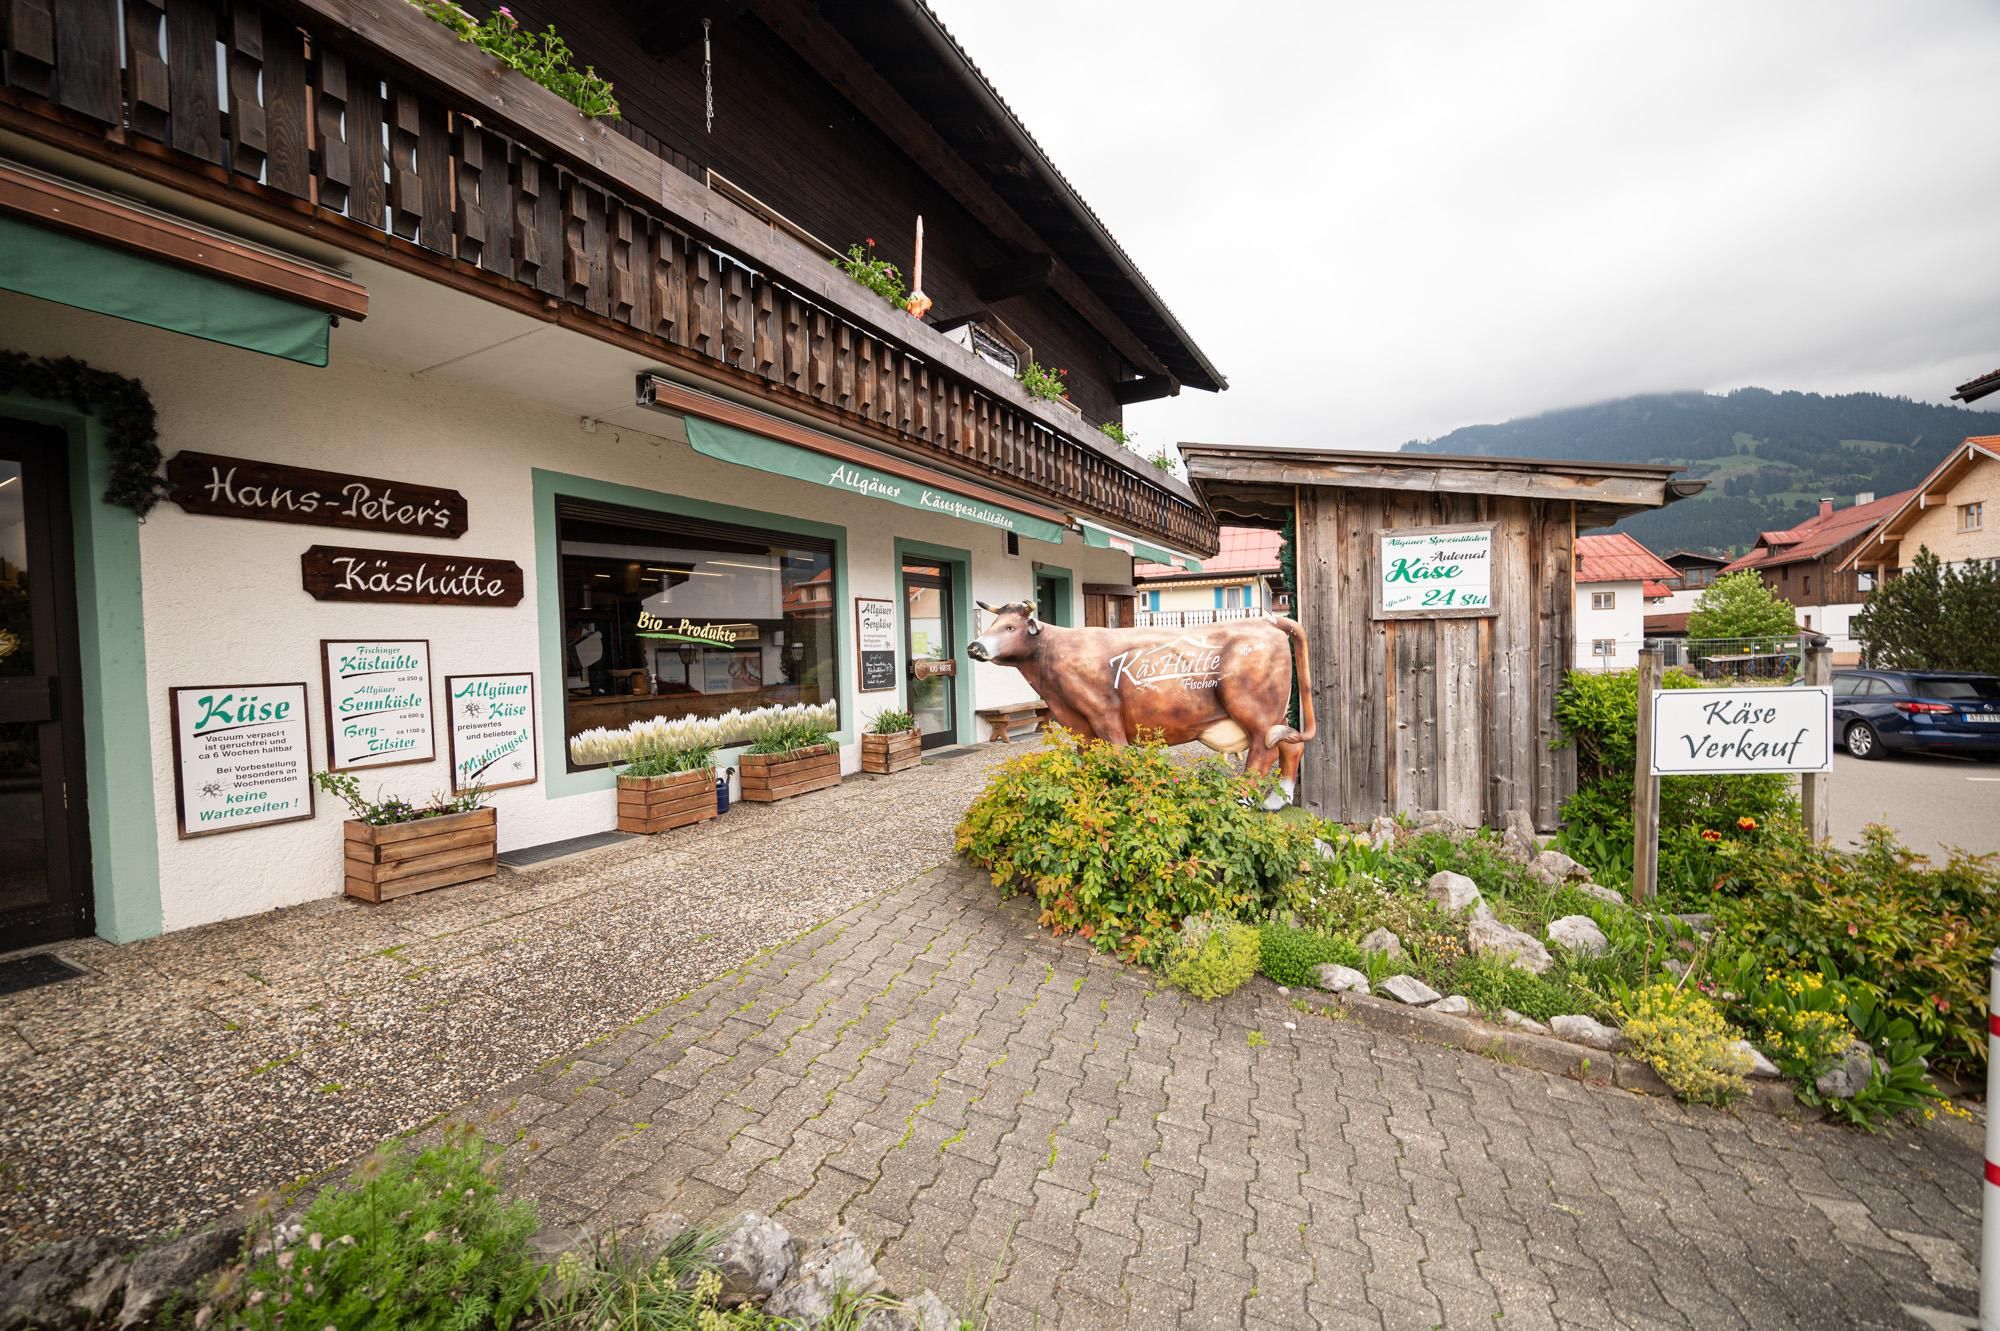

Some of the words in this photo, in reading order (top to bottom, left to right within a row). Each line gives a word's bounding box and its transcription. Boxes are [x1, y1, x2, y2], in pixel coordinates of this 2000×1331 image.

[204, 467, 450, 529] Hans-Peter's
[828, 464, 901, 497] Allgäuer
[920, 490, 1014, 529] Käsespezialitäten
[332, 557, 505, 597] Käshütte
[1385, 557, 1463, 584] Käse
[1421, 588, 1456, 606] 24
[1460, 593, 1488, 606] Std
[637, 611, 663, 631] Bio
[678, 618, 737, 643] Produkte
[357, 646, 400, 656] Fischinger
[339, 655, 419, 673] Käslaible
[354, 686, 396, 695] Allgäuer
[454, 681, 528, 700] Allgäuer
[1183, 675, 1218, 690] Fischen
[338, 693, 422, 712] Sennkäsle
[488, 702, 526, 720] Käse
[194, 694, 290, 730] Käse
[1702, 700, 1776, 726] Käse
[457, 721, 502, 732] preiswertes
[483, 729, 517, 739] beliebtes
[205, 743, 217, 751] ist
[219, 740, 267, 751] geruchfrei
[206, 733, 244, 743] Vacuum
[367, 738, 416, 751] Tilsiter
[1680, 728, 1809, 764] Verkauf
[213, 751, 219, 759] 6
[222, 745, 260, 758] Wochen
[262, 745, 293, 753] haltbar
[458, 728, 529, 772] Mitbringsel
[216, 766, 232, 774] Bei
[235, 760, 297, 773] Vorbestellung
[236, 769, 284, 780] besonders
[233, 775, 298, 789] Wochenenden
[226, 791, 268, 804] keine
[199, 800, 289, 822] Wartezeiten
